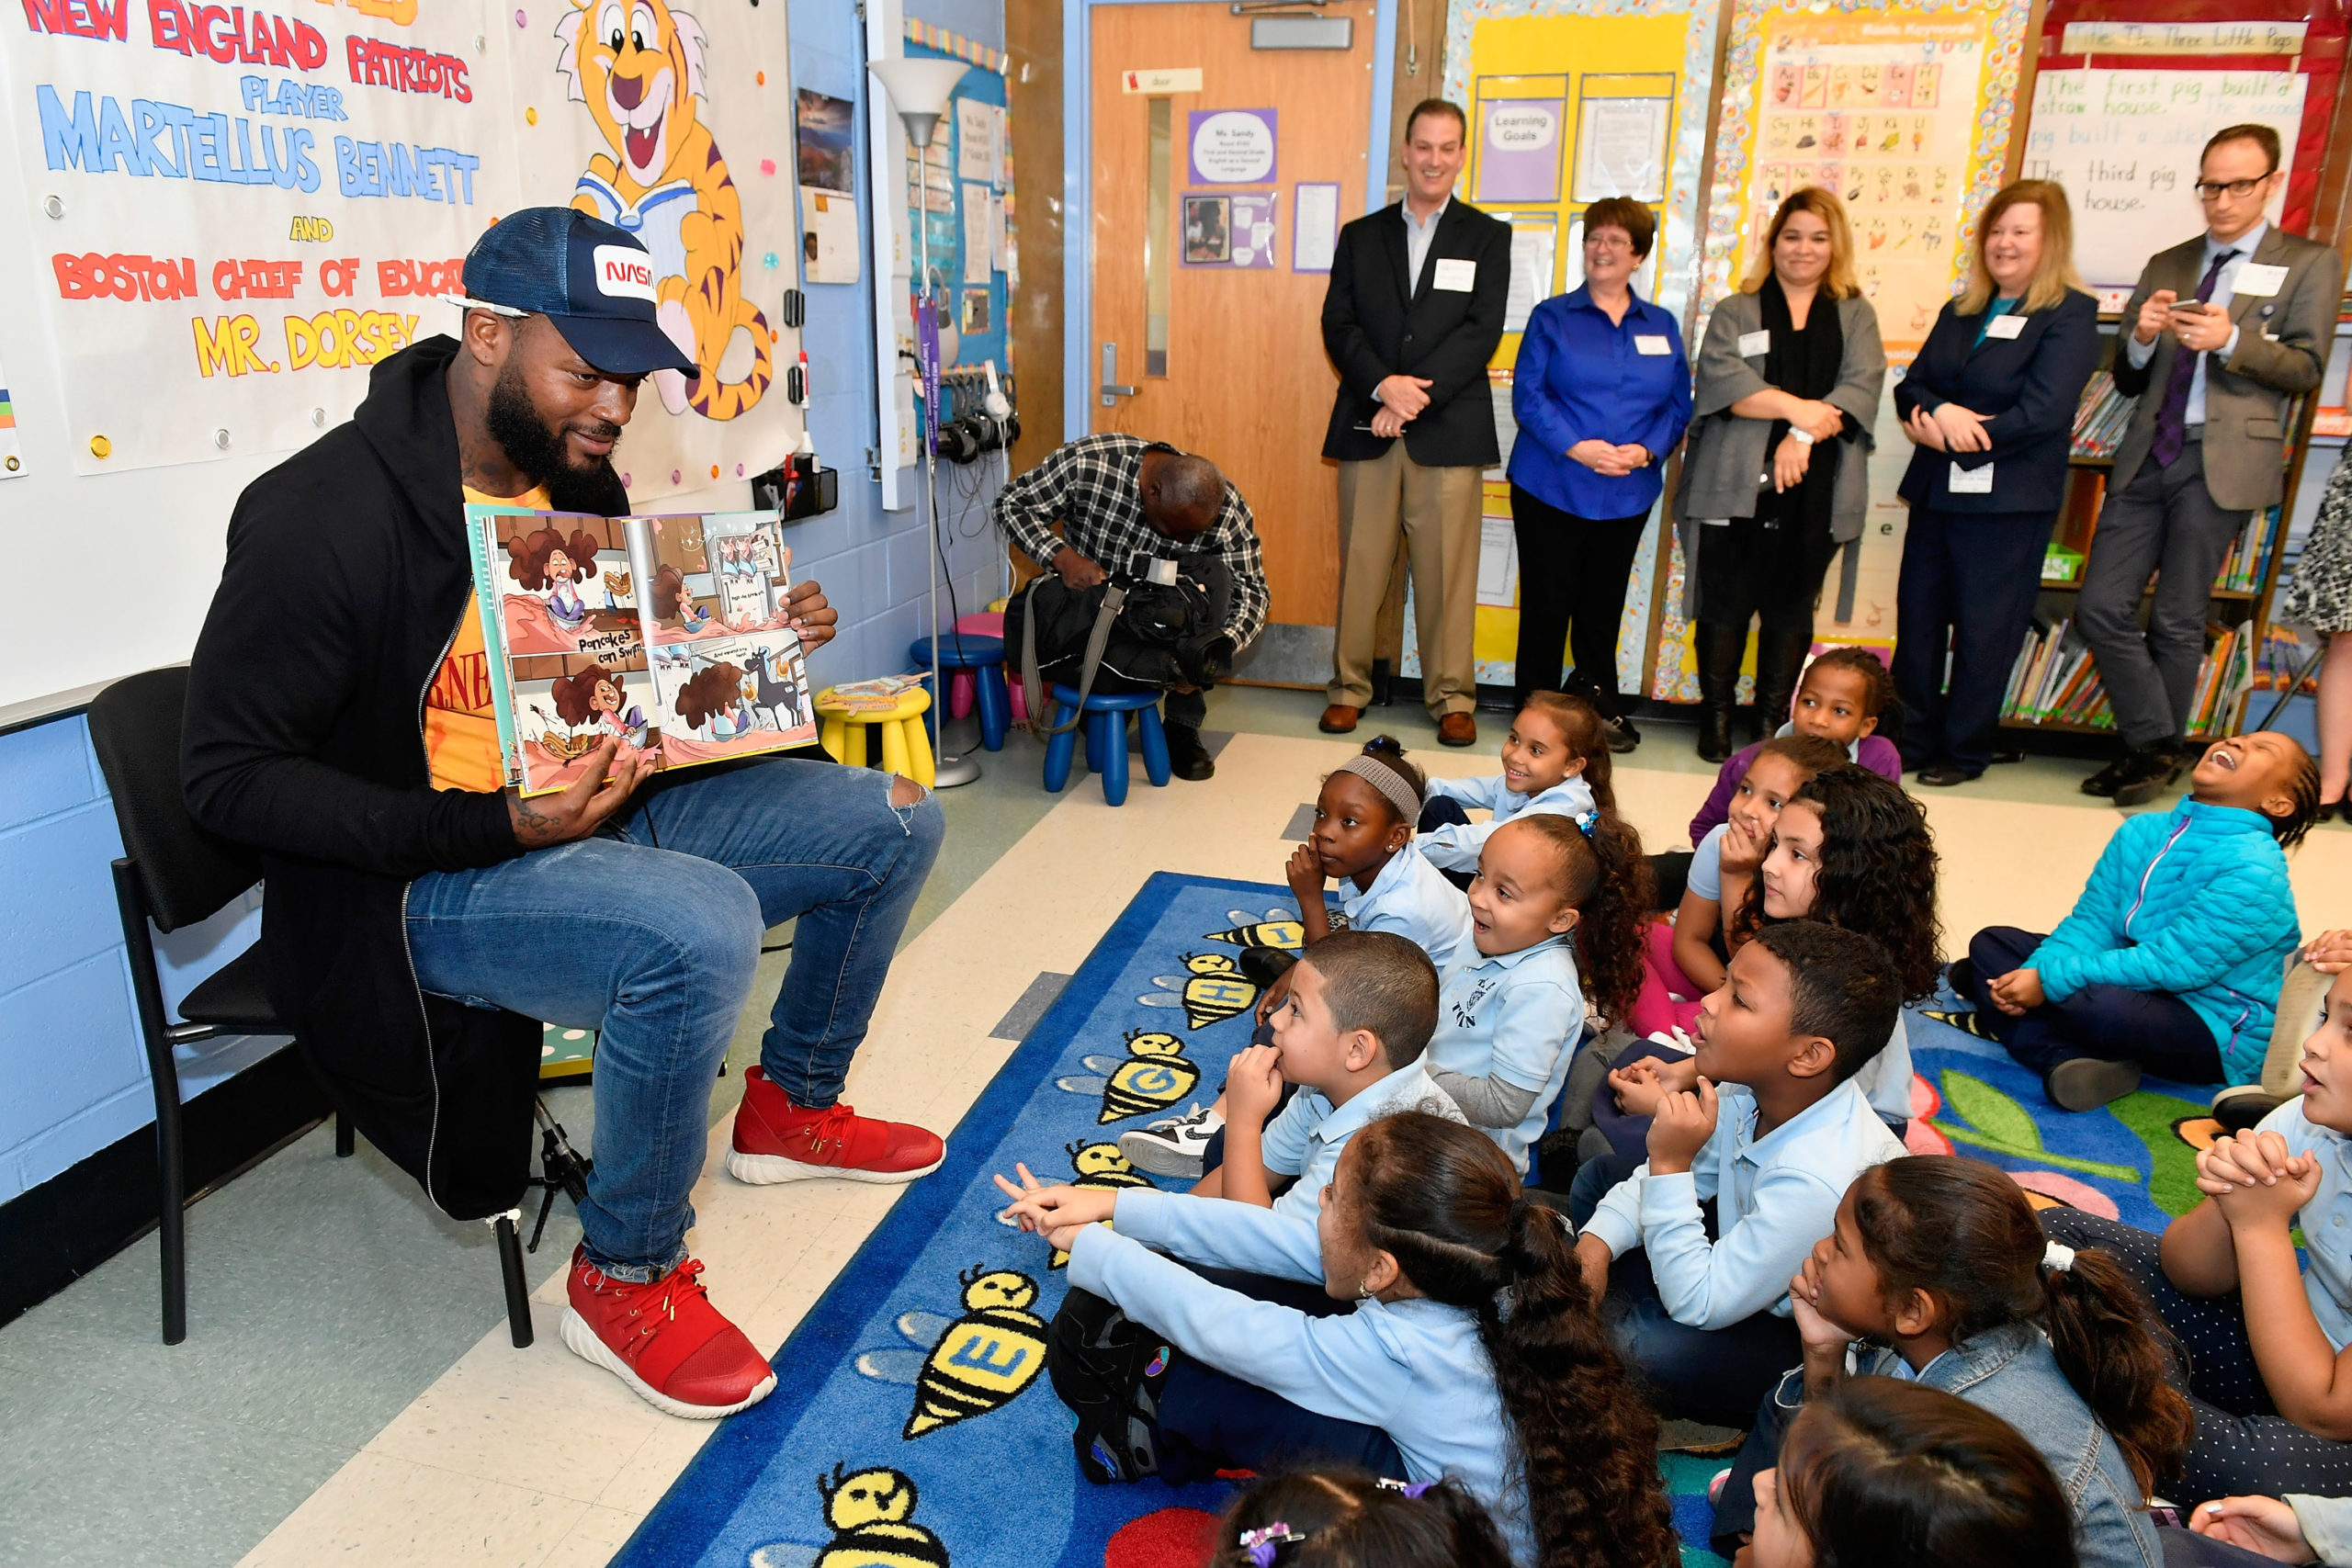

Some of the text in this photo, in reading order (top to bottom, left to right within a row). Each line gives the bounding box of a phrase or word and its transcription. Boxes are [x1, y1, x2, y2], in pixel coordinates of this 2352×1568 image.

[22, 0, 472, 104] NEW ENGLAND PATRIOTS
[2213, 26, 2256, 46] Little
[2267, 27, 2292, 51] Pigs
[241, 75, 348, 121] PLAYER
[2042, 73, 2085, 96] The
[2171, 81, 2202, 104] pig
[2222, 74, 2268, 96] built
[1496, 116, 1547, 128] Learning
[36, 85, 479, 205] MARTELLUS BENNETT
[1503, 131, 1537, 141] Goals
[2027, 160, 2176, 190] The third pig
[2083, 187, 2145, 211] house.
[289, 217, 334, 242] AND
[51, 253, 198, 301] BOSTON
[212, 258, 302, 300] CHIEF
[320, 257, 359, 296] OF
[606, 261, 654, 290] NASA
[192, 310, 420, 378] MR. DORSEY
[1881, 524, 1893, 536] e
[579, 629, 631, 652] Pancakes
[598, 643, 642, 663] can Swim
[1198, 984, 1245, 1003] H
[1127, 1066, 1174, 1093] G
[947, 1336, 1027, 1377] E
